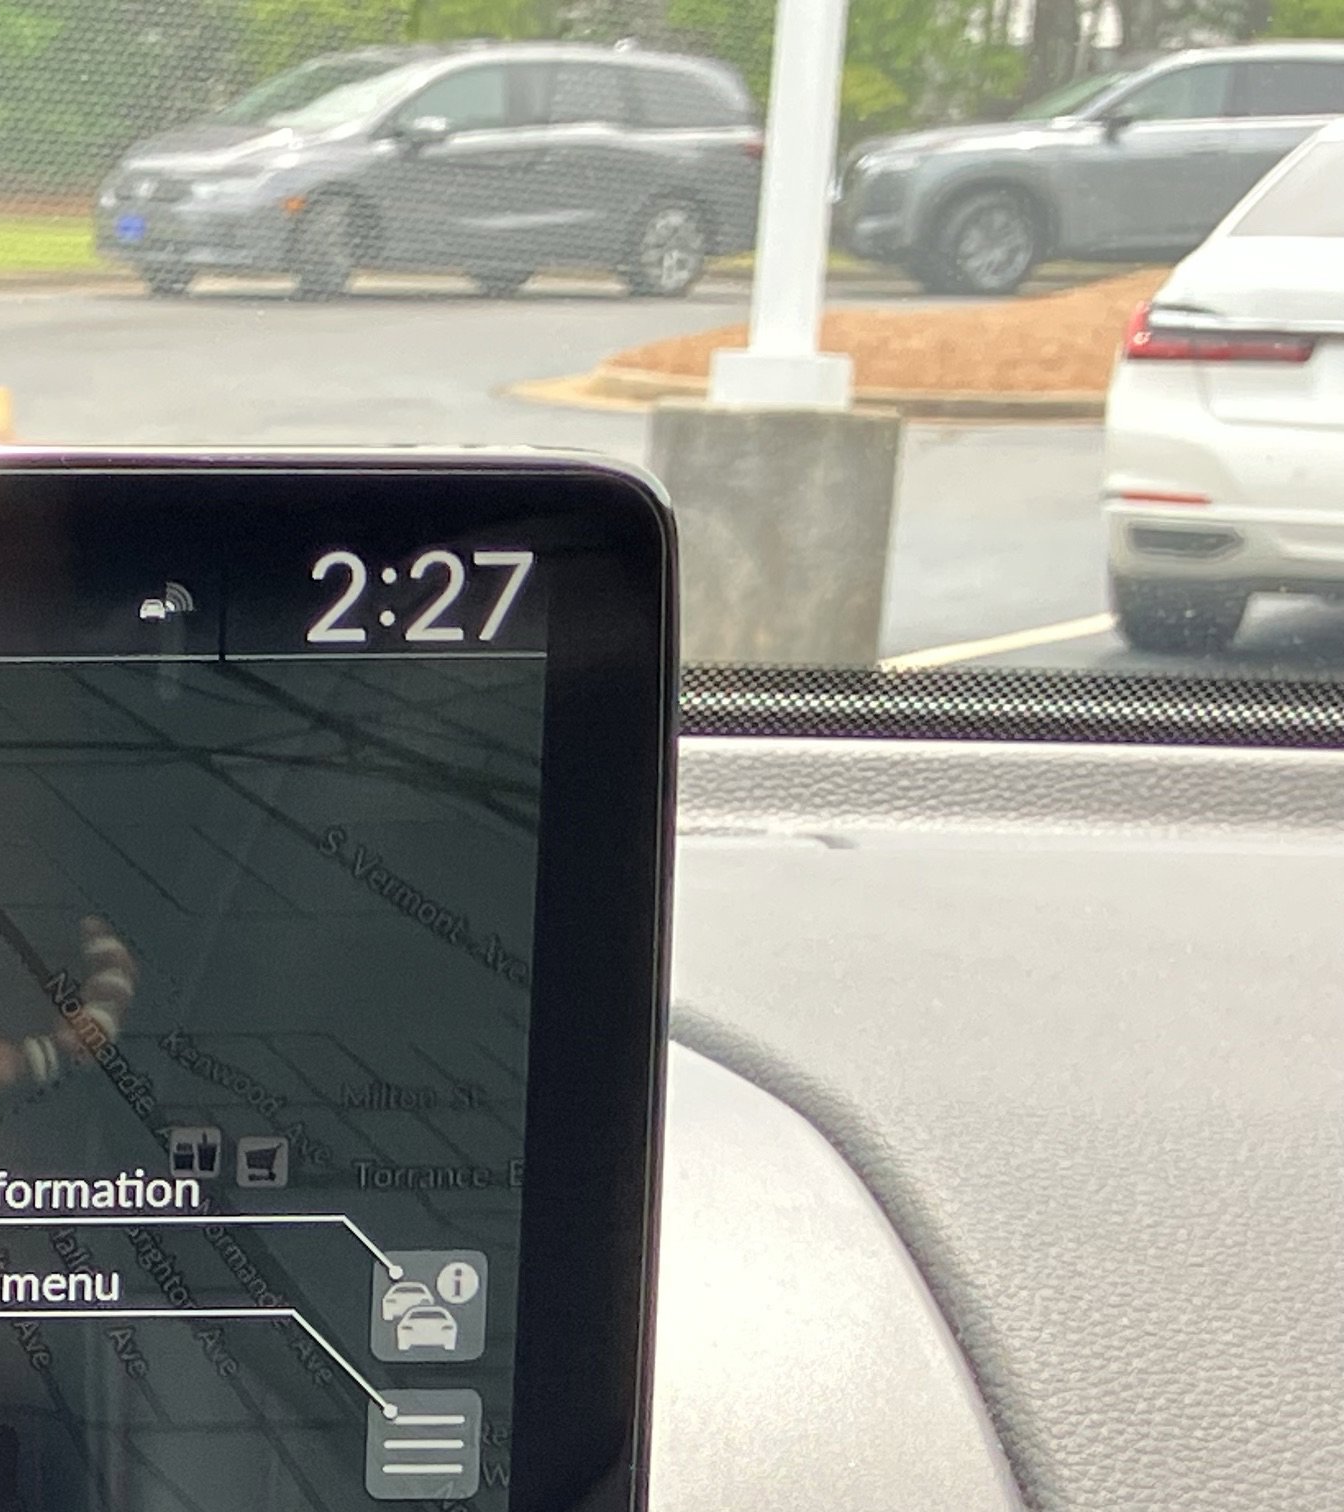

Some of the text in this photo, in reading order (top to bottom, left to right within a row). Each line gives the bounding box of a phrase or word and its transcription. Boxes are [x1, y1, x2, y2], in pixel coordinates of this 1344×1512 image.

[307, 550, 535, 642] 2:27
[352, 845, 470, 946] Vermont
[158, 1026, 334, 1167] Kenwood Ave
[450, 1083, 486, 1109] St
[352, 1160, 493, 1190] Torrance
[2, 1271, 120, 1304] menu
[15, 1320, 53, 1370] Ave
[109, 1326, 150, 1379] Ave
[196, 1326, 239, 1379] Ave
[290, 1337, 335, 1389] Ave
